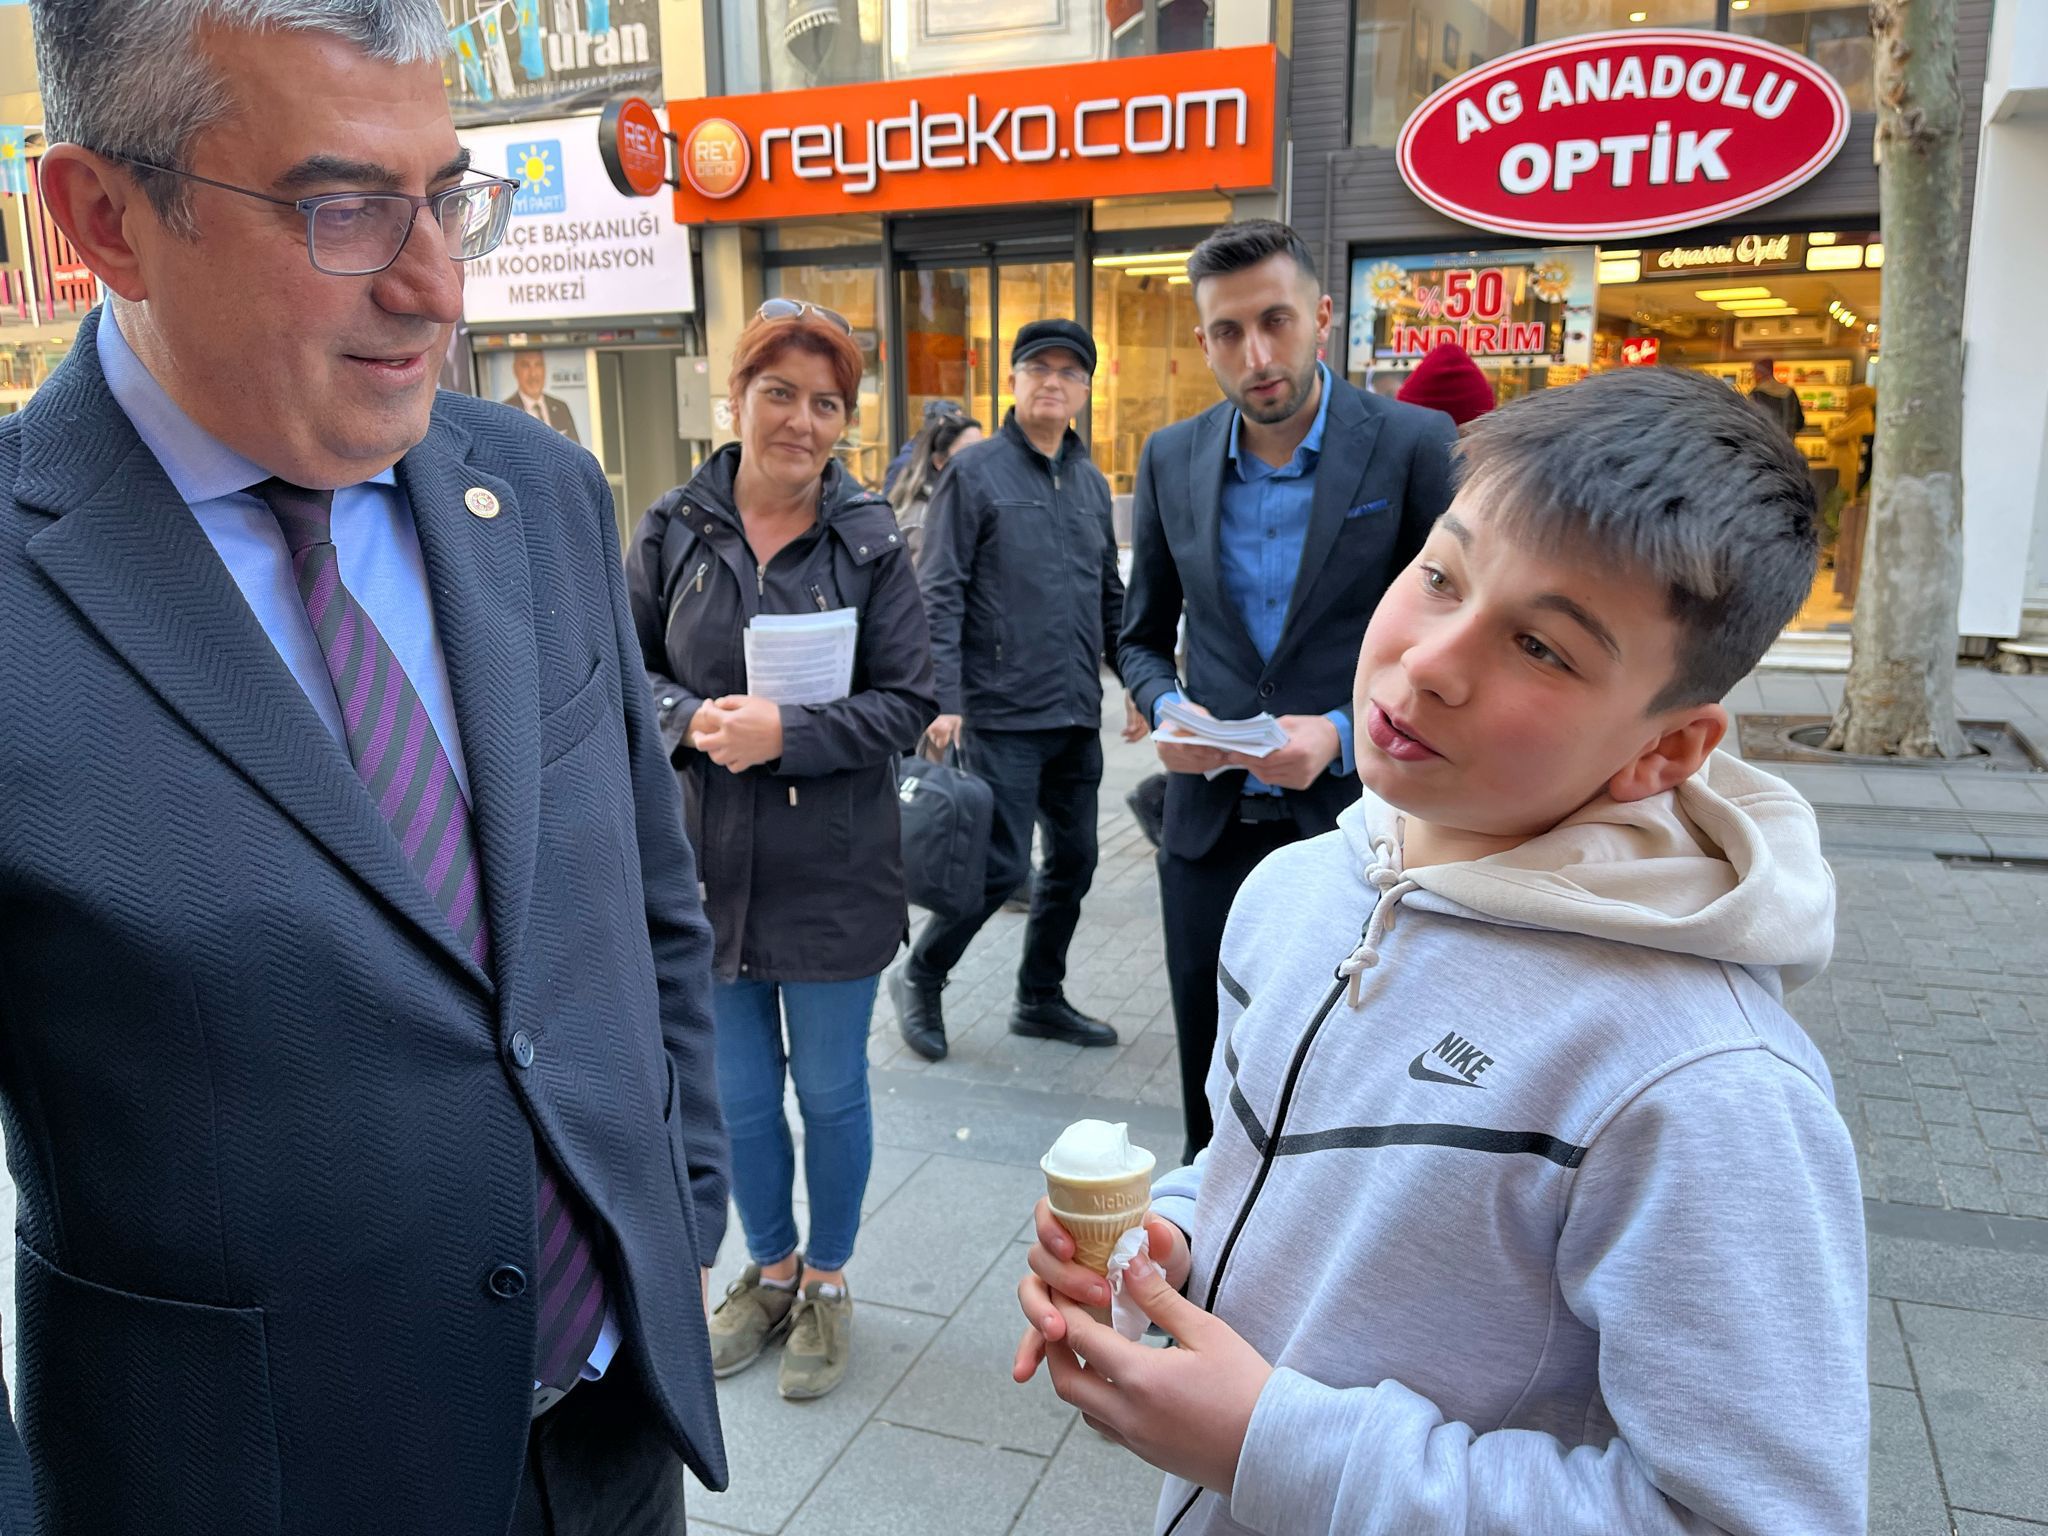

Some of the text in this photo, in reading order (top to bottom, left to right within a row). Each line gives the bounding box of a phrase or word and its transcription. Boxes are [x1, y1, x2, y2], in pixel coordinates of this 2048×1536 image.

[539, 22, 650, 72] uran
[1456, 54, 1799, 144] AG ANADOLU
[623, 120, 659, 155] REY
[694, 140, 737, 162] REY
[760, 87, 1247, 193] reydeko.com
[1499, 120, 1734, 196] OPTİK
[543, 211, 660, 247] BAŞKANLIĞI
[498, 246, 654, 277] KOORDİNASYON
[1736, 234, 1790, 267] Optik
[508, 276, 586, 306] MERKEZİ
[1416, 266, 1505, 322] %50
[1392, 316, 1546, 357] İNDİRİM
[1431, 1030, 1495, 1083] NIKE
